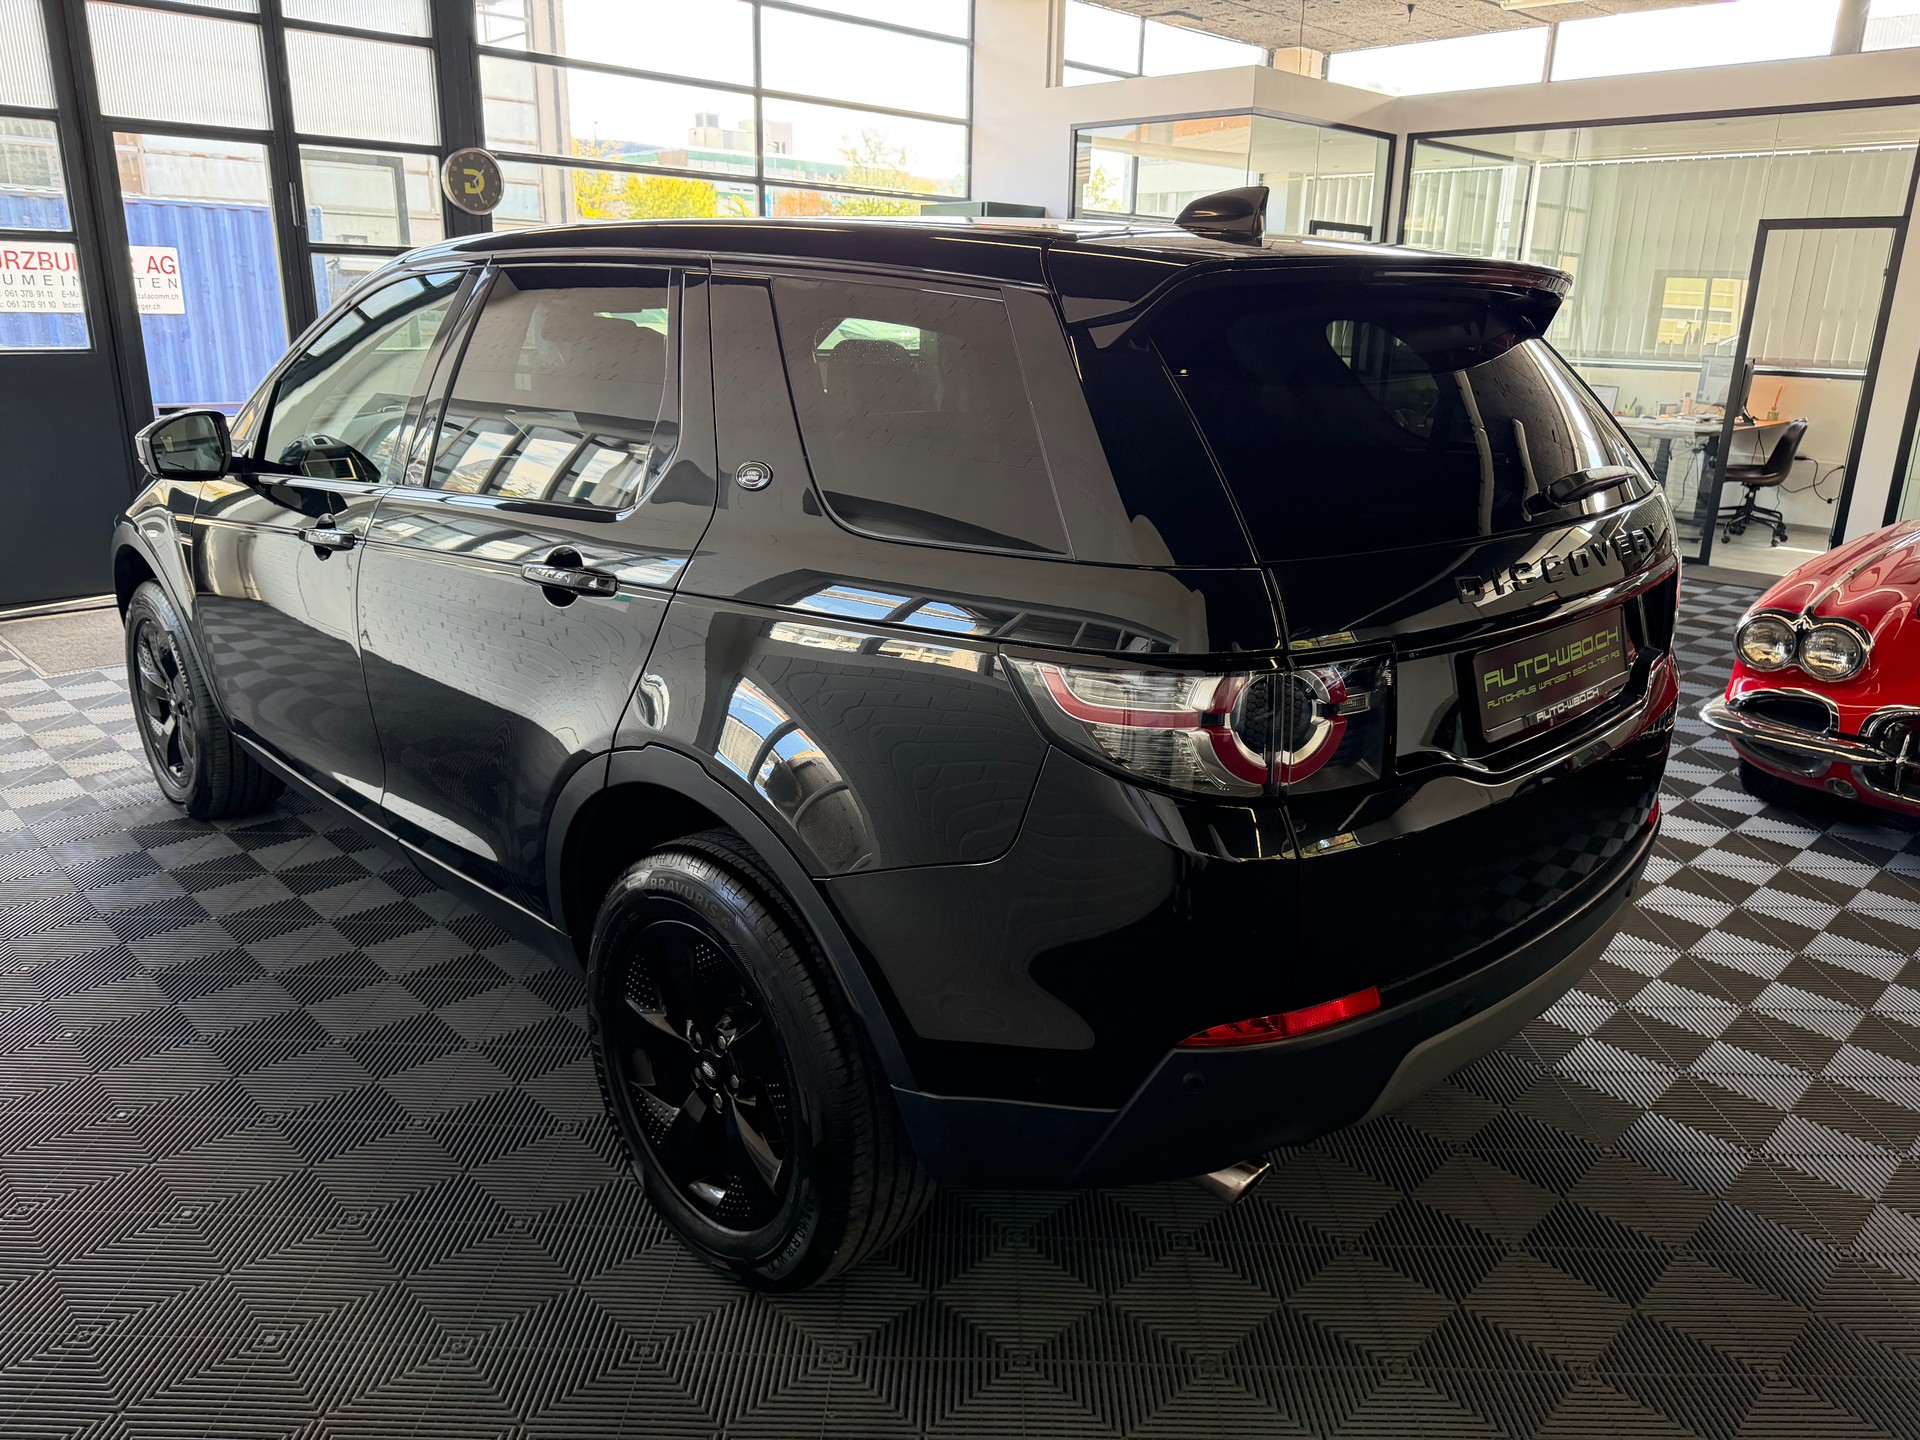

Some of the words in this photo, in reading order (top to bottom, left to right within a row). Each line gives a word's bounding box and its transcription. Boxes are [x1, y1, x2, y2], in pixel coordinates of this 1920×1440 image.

[146, 255, 176, 275] AG
[4, 289, 18, 298] 061
[20, 290, 34, 298] 378
[36, 290, 45, 298] 91
[6, 300, 20, 308] 061
[22, 301, 36, 309] 378
[1454, 523, 1656, 604] DISCOVERY
[1483, 626, 1619, 693] AUTO-WBO.CH
[1487, 684, 1537, 709] AUTOHAUS
[1610, 649, 1621, 660] AG
[1536, 687, 1600, 723] AUTO-WBO.CH
[650, 877, 719, 917] BRAVURIS
